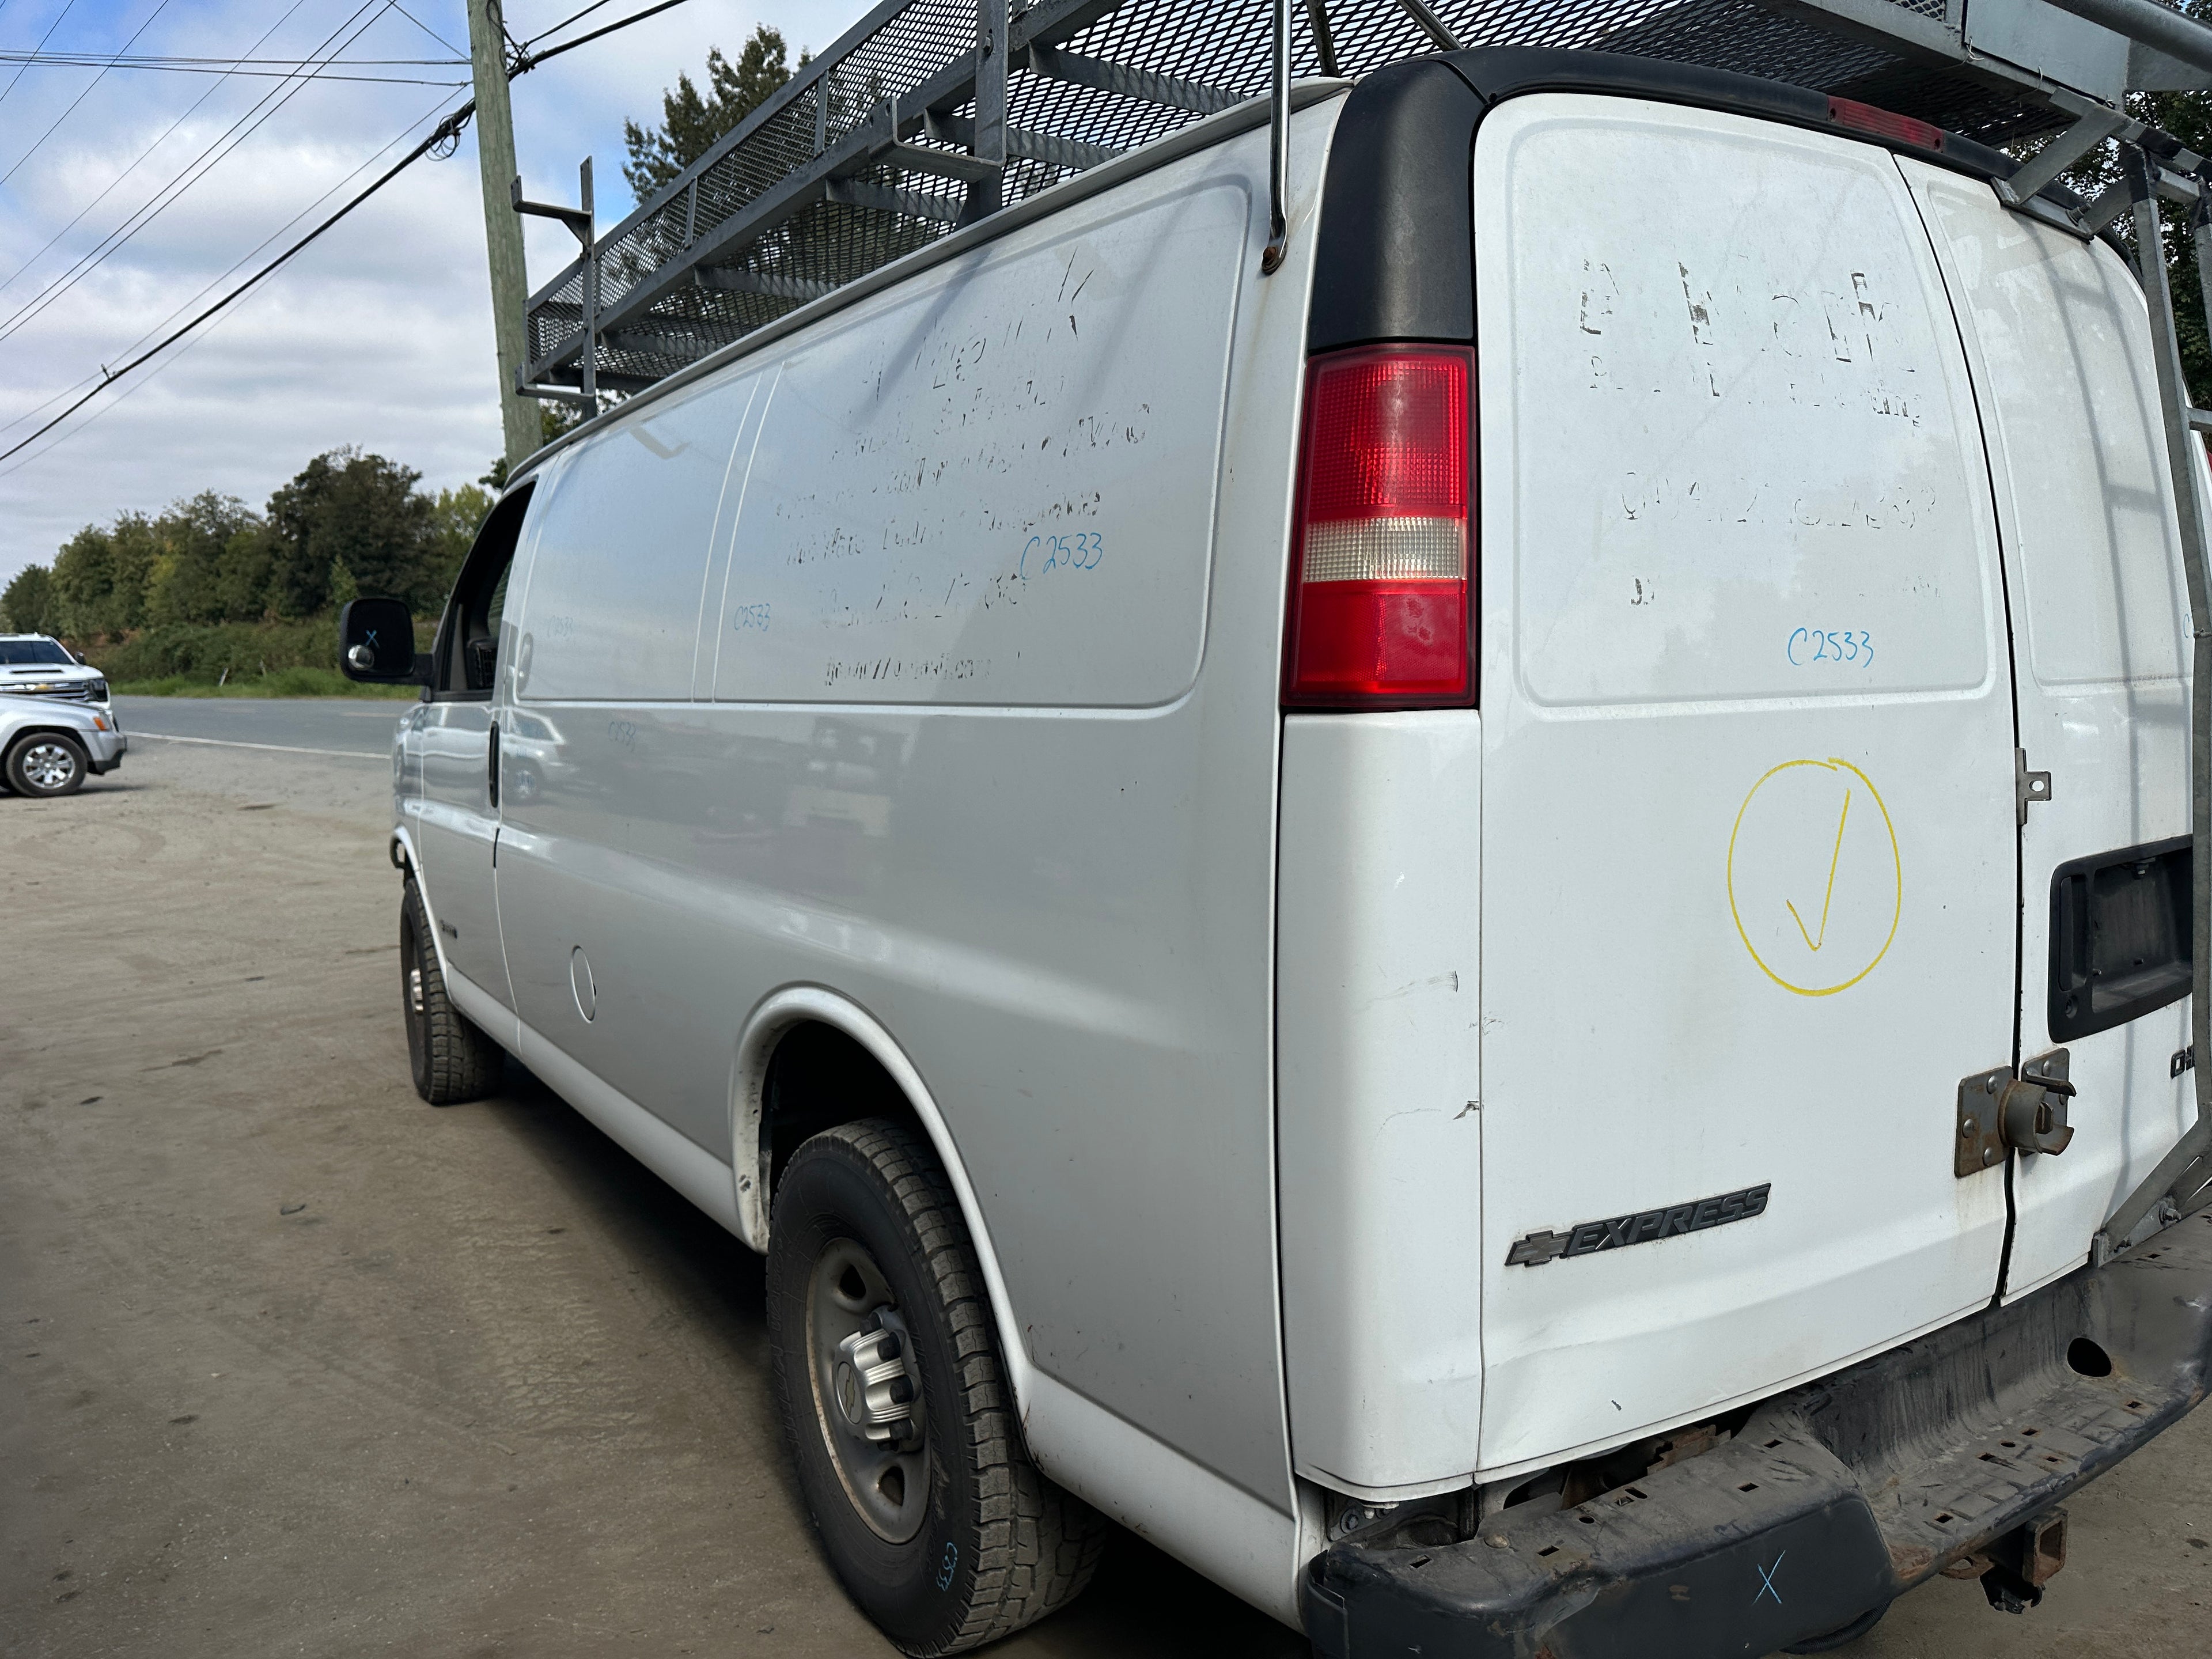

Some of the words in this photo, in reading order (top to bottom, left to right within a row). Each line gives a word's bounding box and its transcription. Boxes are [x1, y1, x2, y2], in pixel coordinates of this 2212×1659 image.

[1020, 532, 1103, 580] C2533
[734, 603, 771, 631] C2533
[1787, 627, 1874, 668] C2533
[1566, 1185, 1770, 1256] EXPRESS
